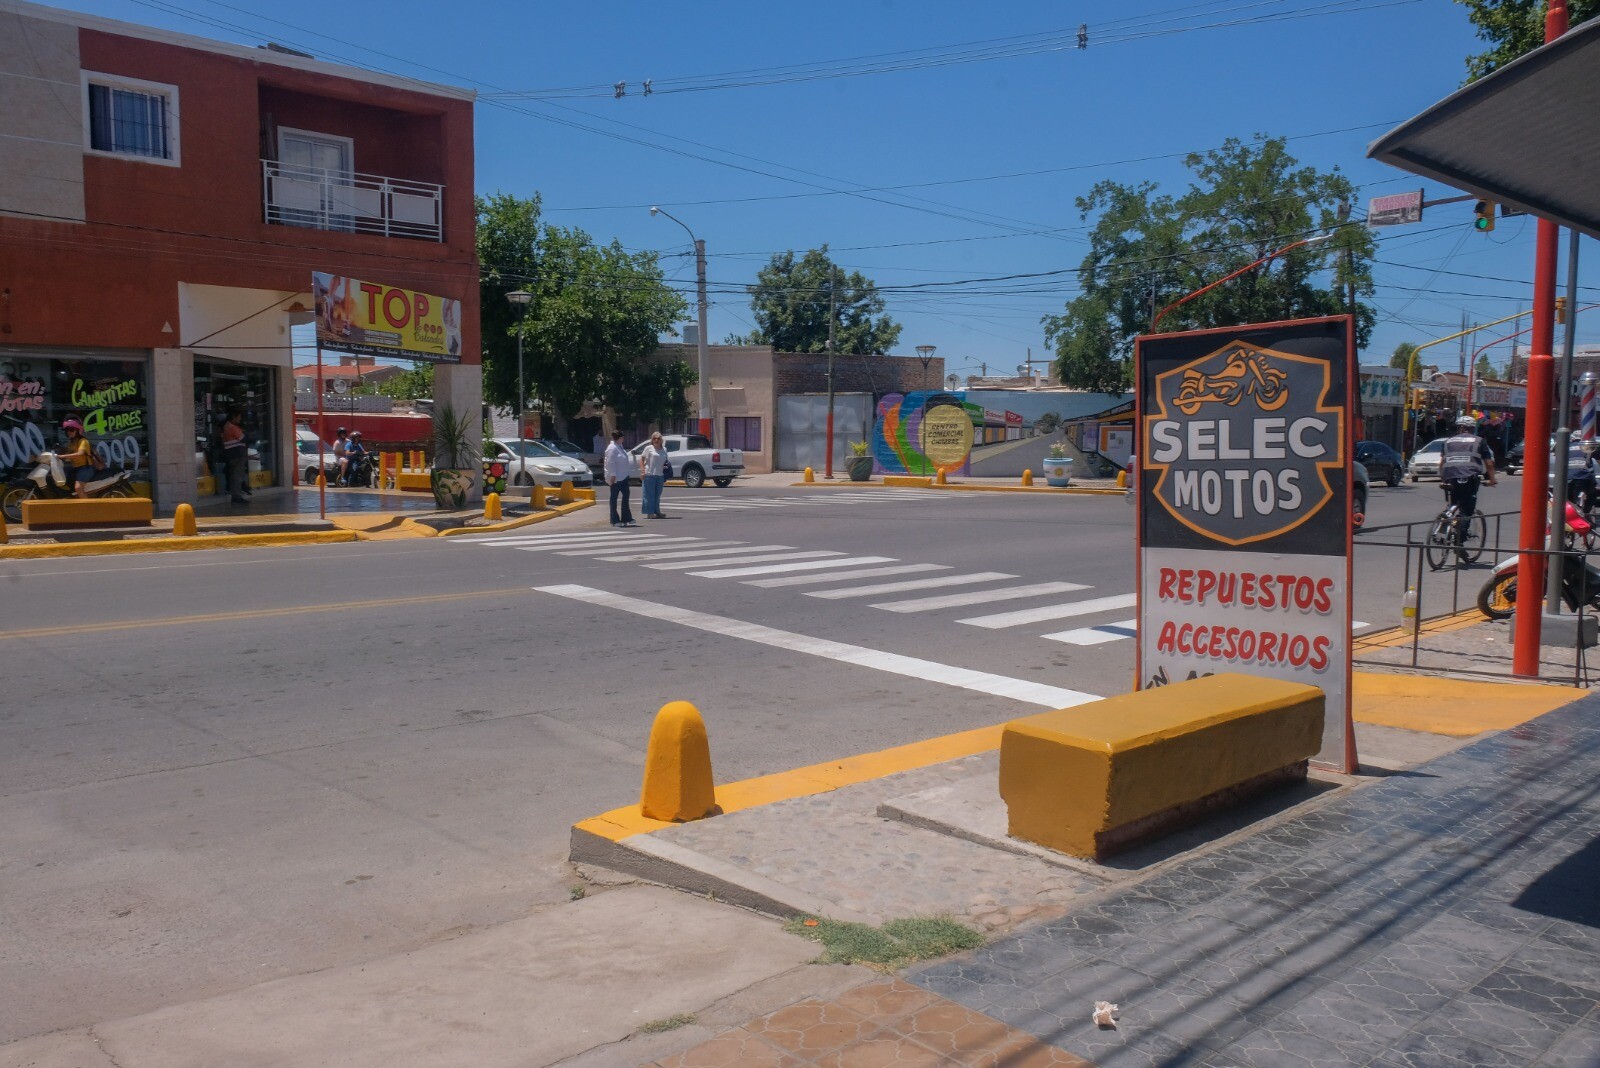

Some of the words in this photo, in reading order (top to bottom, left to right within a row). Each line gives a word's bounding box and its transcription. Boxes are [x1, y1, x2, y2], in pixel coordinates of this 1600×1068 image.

[83, 408, 107, 435] 4
[108, 410, 142, 431] PARES
[928, 430, 964, 438] COMERCIAL
[1152, 416, 1330, 463] SELEC
[1173, 468, 1303, 519] MOTOS
[1158, 567, 1334, 613] REPUESTOS
[1156, 620, 1331, 671] ACCESORIOS
